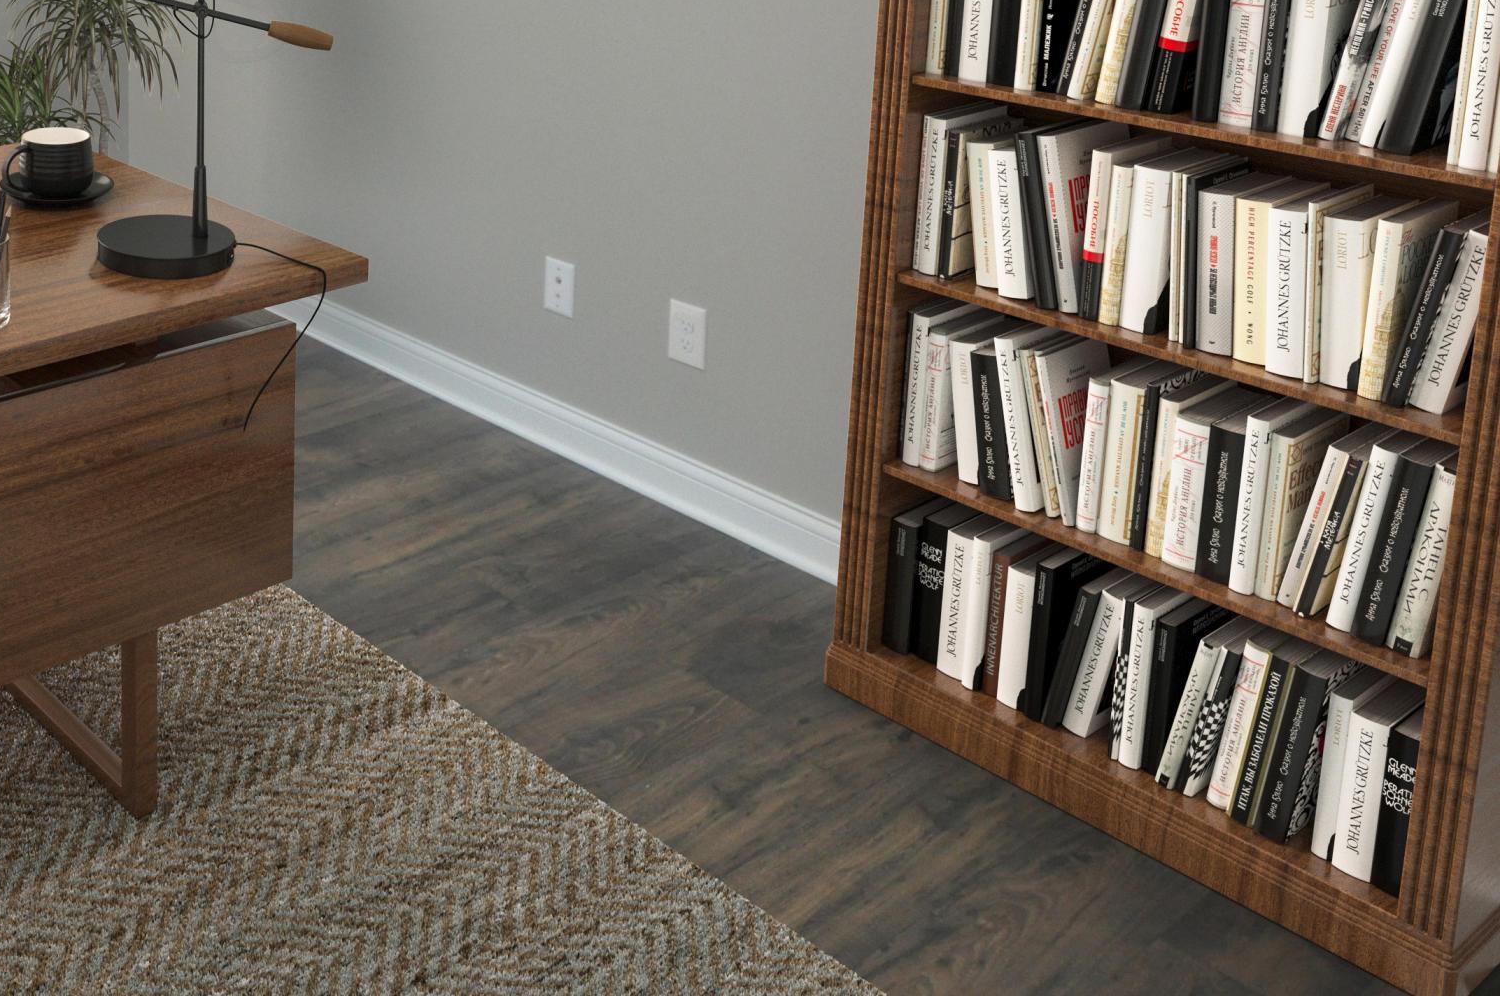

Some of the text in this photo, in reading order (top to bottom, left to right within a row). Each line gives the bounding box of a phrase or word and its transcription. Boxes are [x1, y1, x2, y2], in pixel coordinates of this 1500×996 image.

[967, 1, 981, 60] JOHANNES
[1391, 2, 1400, 23] LOVE
[1044, 25, 1053, 61] МАЛЕЖИК
[1232, 14, 1250, 104] ИСТОРИЯ АНГЛИИ
[1371, 61, 1381, 80] LIFE
[1377, 38, 1389, 61] YOUR
[1361, 80, 1375, 108] AFTER
[1470, 57, 1488, 140] JOHANNES
[1089, 200, 1100, 247] ПОСОБИЕ
[1143, 180, 1155, 218] LORIOT
[1001, 216, 1015, 276] JOHANNES
[1246, 230, 1255, 281] PERCENTAGE
[1336, 230, 1349, 270] LORIOT
[1246, 284, 1254, 305] GOLF
[1276, 283, 1290, 352] JOHANNES
[1427, 246, 1486, 386] JOHANNES GRÜTZKE
[1176, 467, 1192, 547] ИСТОРИЯ АНГЛИИ
[1237, 498, 1252, 568] JOHANNES
[1340, 531, 1366, 604] JOHANNES
[987, 563, 1003, 676] INNENARCHITEKTUR
[1016, 582, 1026, 613] LORIOT
[946, 599, 960, 657] JOHANNES
[1074, 658, 1097, 714] JOHANNES
[1238, 672, 1282, 811] ИТАК, ВЫ ЗАБОЛЕЛИ ПРОКАЗОЙ
[1333, 709, 1343, 746] LORIOT
[1347, 729, 1373, 855] JOHANNES GRÜTZKE
